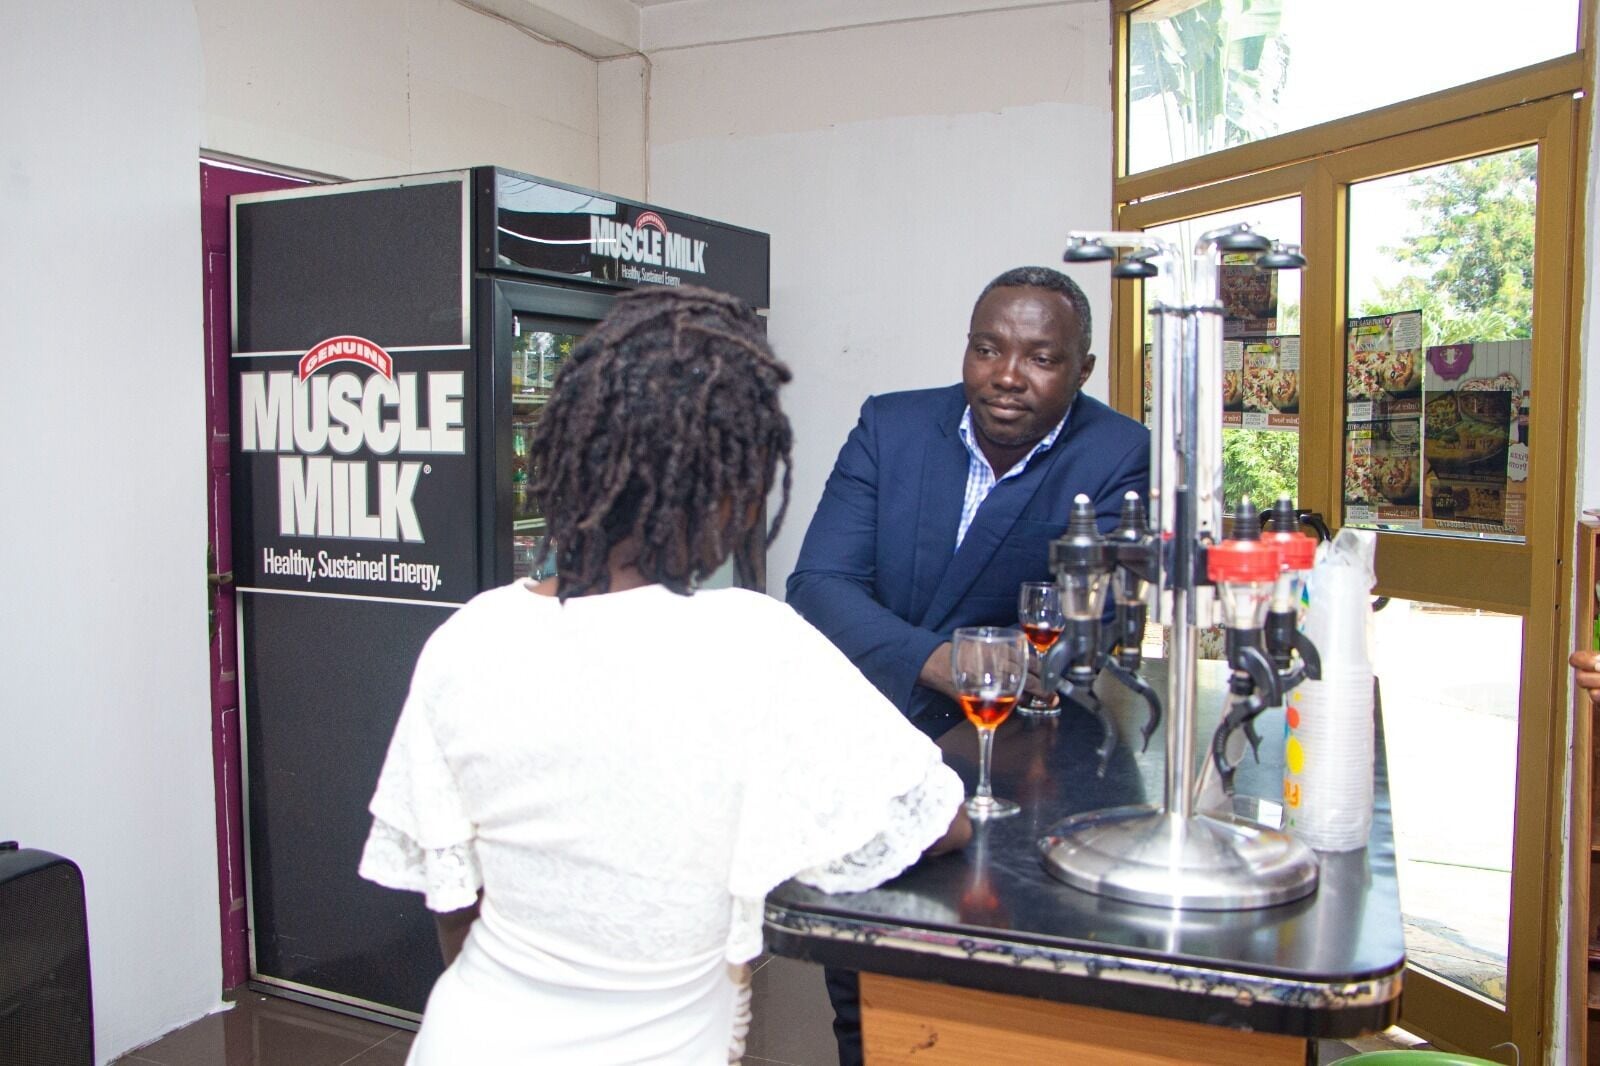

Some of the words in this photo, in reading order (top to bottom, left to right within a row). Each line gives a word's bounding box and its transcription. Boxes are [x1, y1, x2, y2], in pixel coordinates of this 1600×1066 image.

[590, 214, 662, 265] MUSCLE
[304, 341, 387, 374] GENUINE
[240, 370, 465, 454] MUSCLE
[263, 547, 316, 583] Healthy,
[318, 551, 386, 582] Sustained
[390, 554, 442, 591] Energy.
